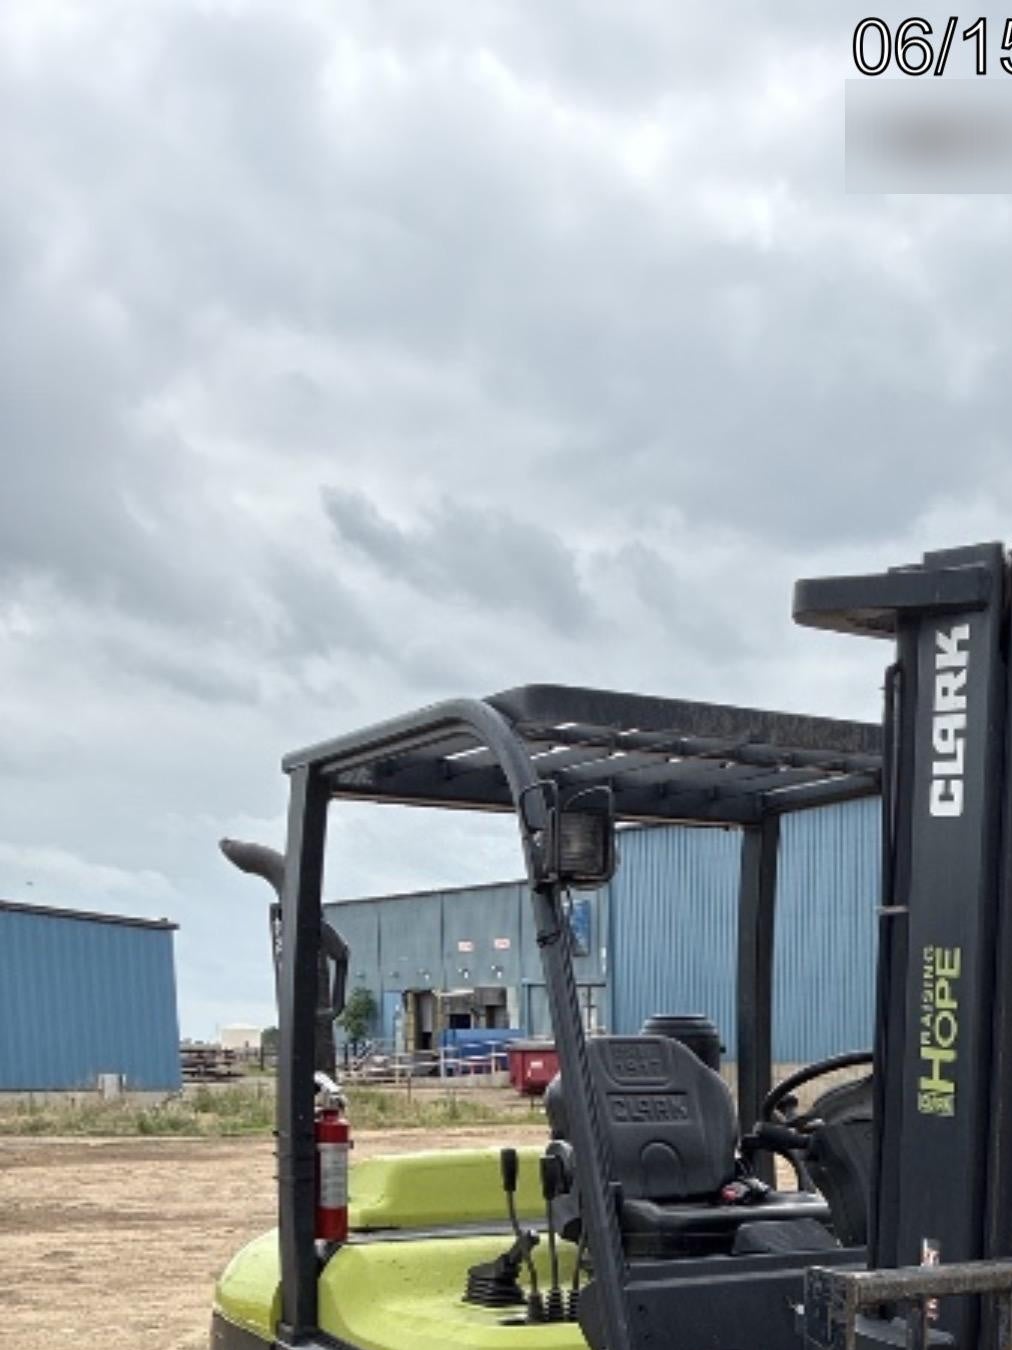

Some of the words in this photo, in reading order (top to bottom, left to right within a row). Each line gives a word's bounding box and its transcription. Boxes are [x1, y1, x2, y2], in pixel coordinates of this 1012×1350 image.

[929, 623, 970, 817] CLARK
[919, 947, 961, 1092] HOPE
[920, 945, 934, 1045] RAISING
